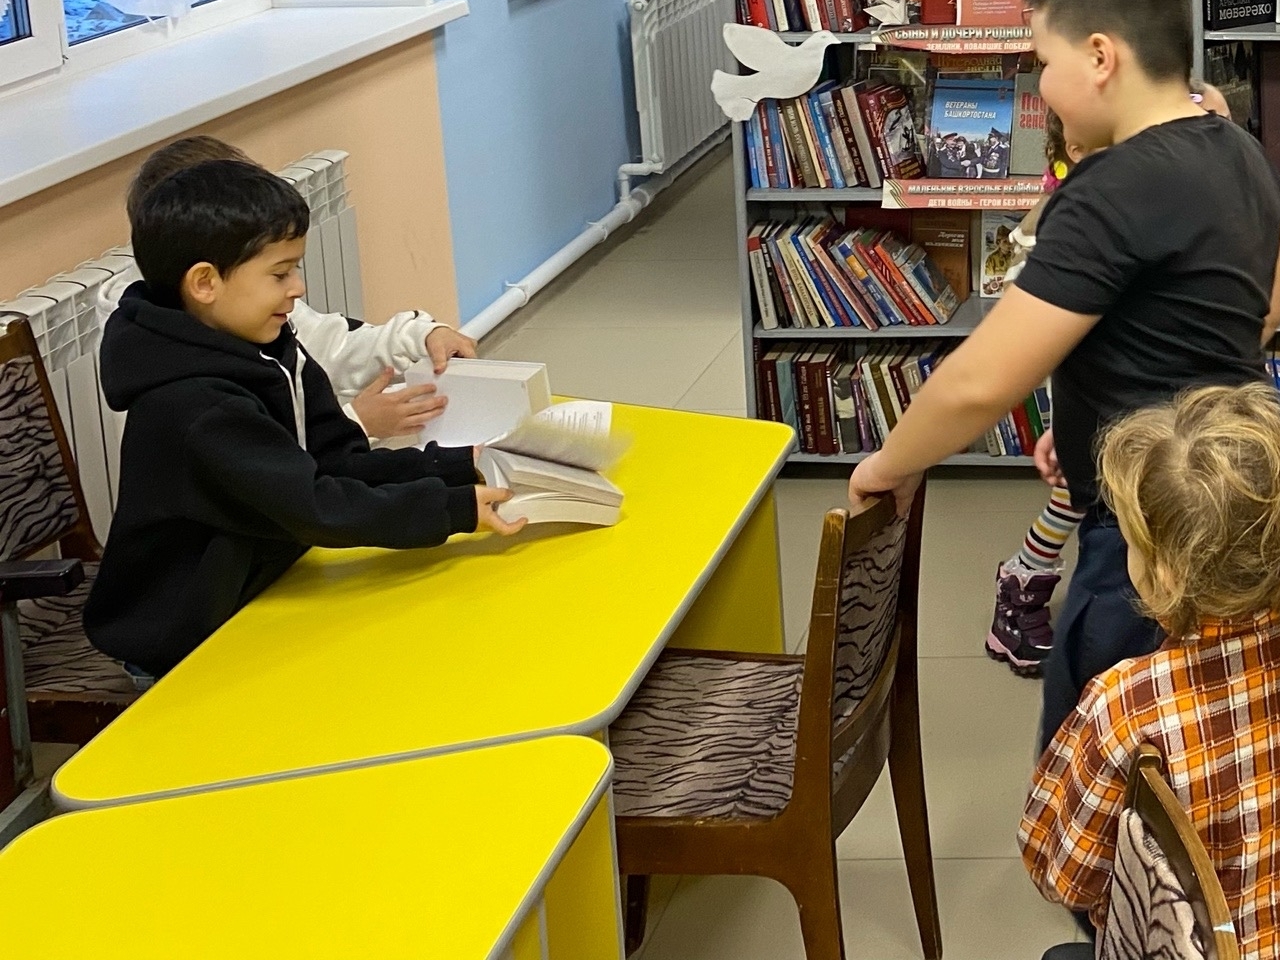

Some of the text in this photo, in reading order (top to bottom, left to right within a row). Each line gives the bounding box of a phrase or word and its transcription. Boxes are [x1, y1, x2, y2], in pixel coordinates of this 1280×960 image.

[1218, 4, 1273, 21] МӨБӘРӘКО
[894, 27, 1033, 41] СЫНЫ И ДОЧЕРИ РОДНОГО
[926, 42, 1032, 52] ЗЕМЛЯКИ, КОВАВШИЕ ПОБЕДУ
[944, 101, 978, 110] ВЕТЕРАНЫ
[944, 110, 997, 120] БАШКОРТОСТАНА
[928, 199, 946, 207] ДЕТИ
[948, 198, 973, 207] ВОЙНЫ
[980, 198, 1002, 207] ГЕРОИ
[1002, 198, 1016, 207] БЕЗ
